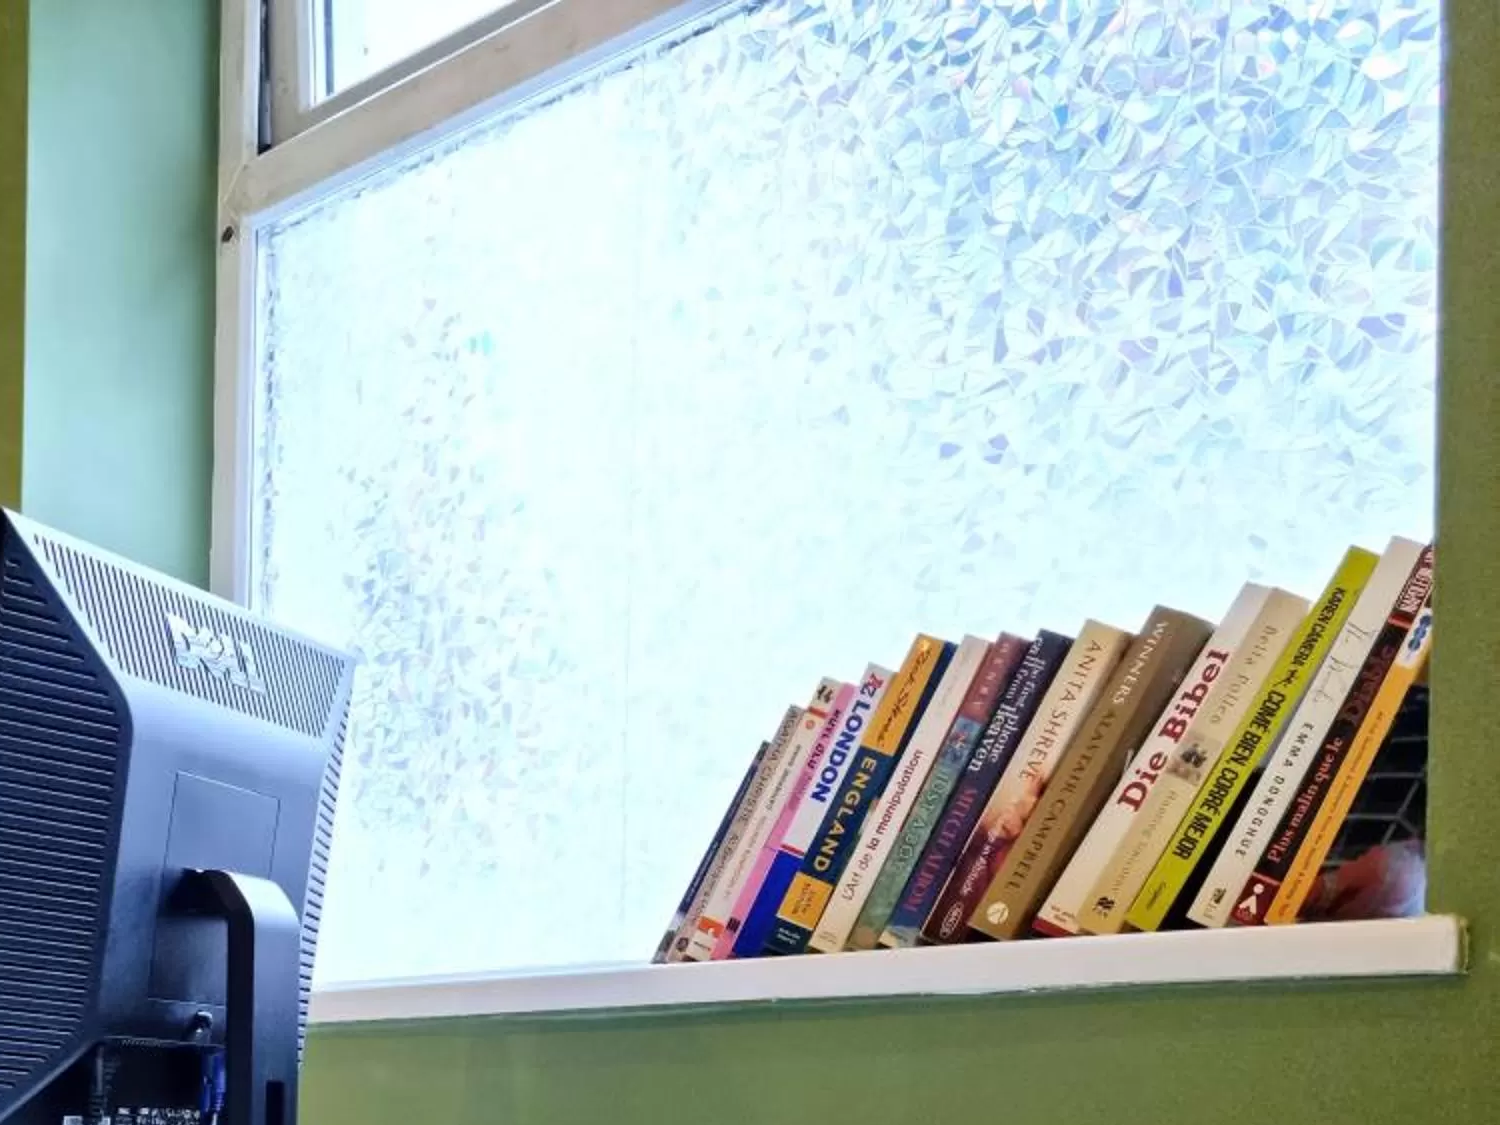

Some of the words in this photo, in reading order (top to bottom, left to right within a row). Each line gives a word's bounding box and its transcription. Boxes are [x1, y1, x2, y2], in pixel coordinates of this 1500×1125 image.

[1317, 587, 1346, 625] KAREN
[1059, 639, 1105, 702] ANITA
[1112, 620, 1169, 705] WINNERS
[810, 699, 871, 803] LONDON
[1018, 707, 1069, 781] SHREVE
[1116, 750, 1169, 814] Die
[1158, 649, 1230, 743] Bibel
[1283, 721, 1314, 768] EMMA
[1327, 735, 1344, 754] le
[1315, 753, 1340, 788] que
[813, 756, 877, 872] ENGLAND
[857, 851, 873, 871] de
[871, 836, 880, 851] la
[876, 748, 925, 837] manipulation
[1172, 812, 1213, 861] MEJOR
[1235, 775, 1286, 858] DONOGHUE
[1289, 787, 1317, 828] malin
[1005, 799, 1066, 890] CAMPBELL
[1267, 825, 1293, 864] Plus
